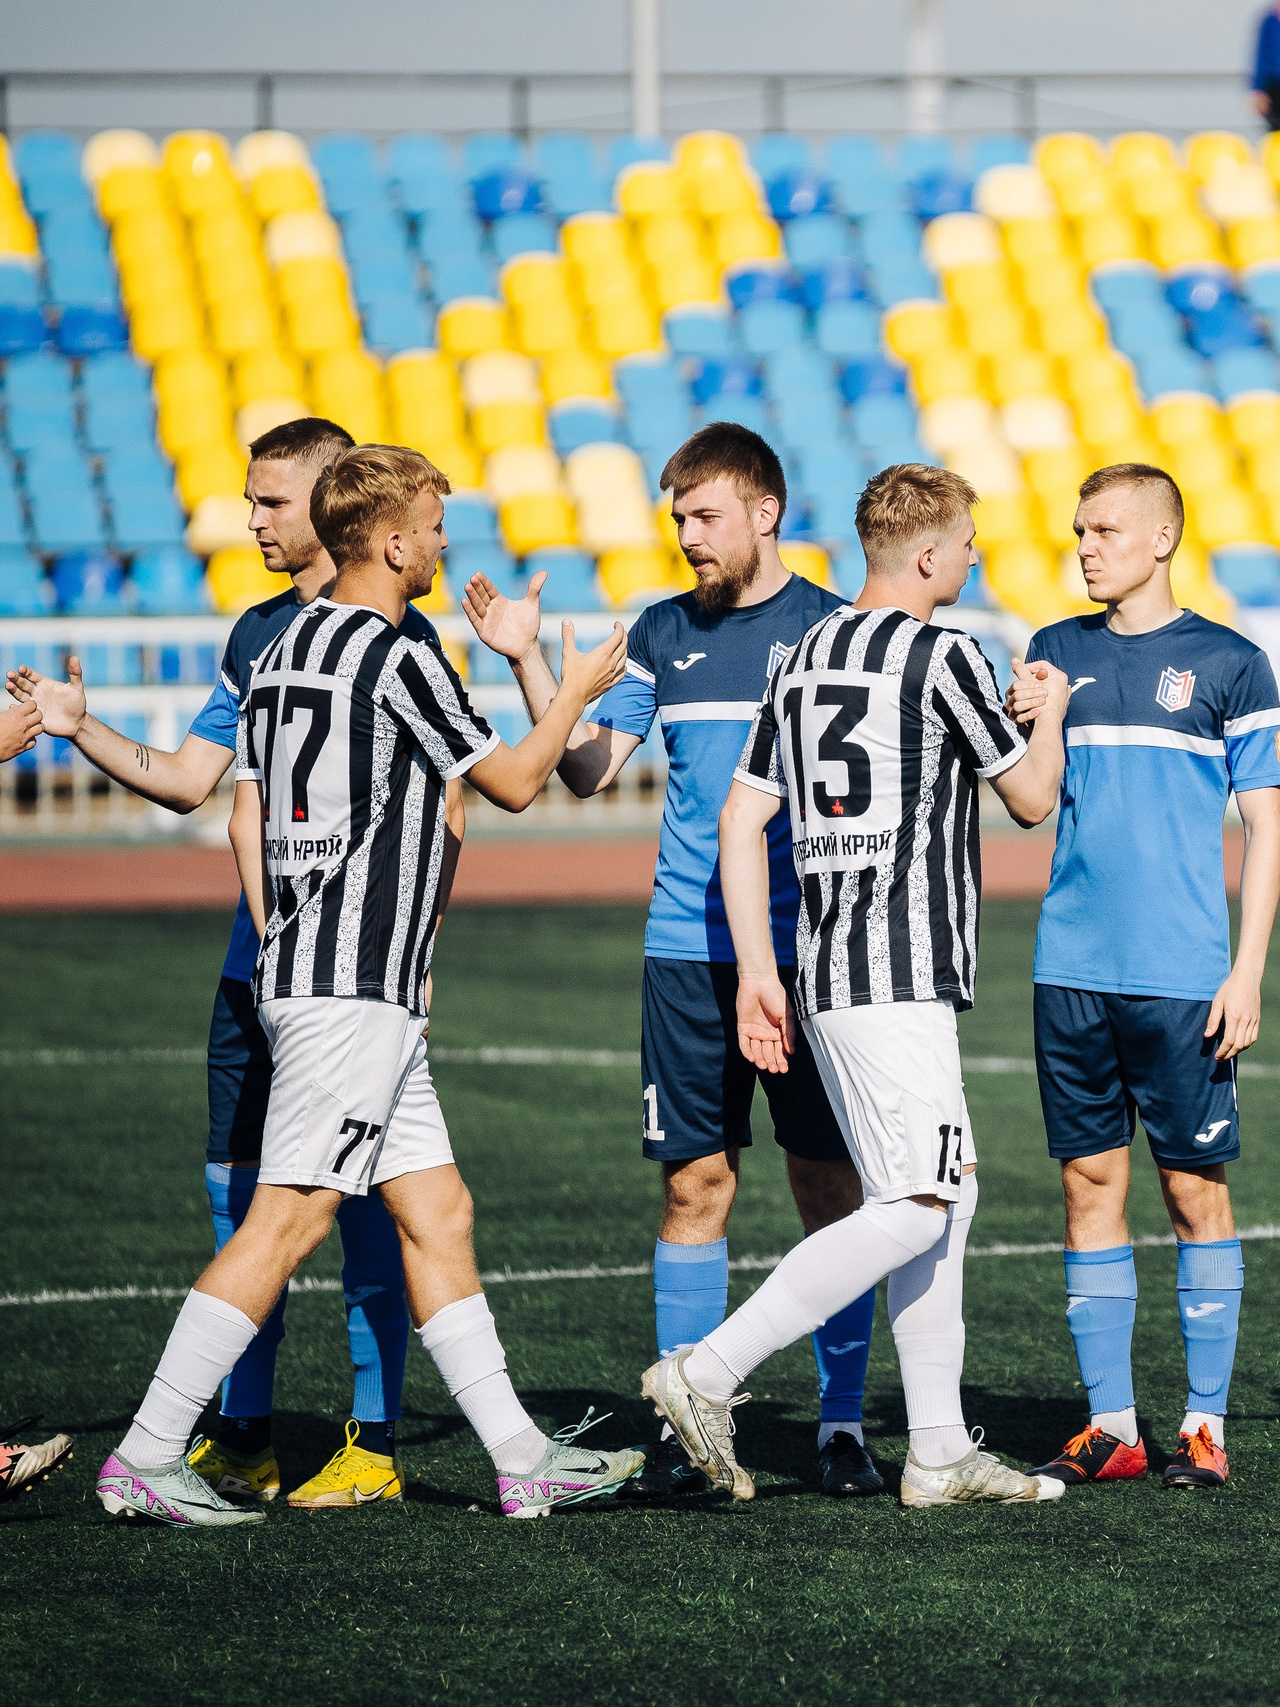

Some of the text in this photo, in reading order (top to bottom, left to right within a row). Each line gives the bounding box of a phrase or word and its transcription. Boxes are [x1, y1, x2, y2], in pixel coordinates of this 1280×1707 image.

[250, 685, 333, 822] 77
[783, 684, 871, 822] 13
[293, 834, 342, 861] КРАЙ
[841, 829, 892, 856] КРАЙ
[643, 1084, 665, 1141] 1
